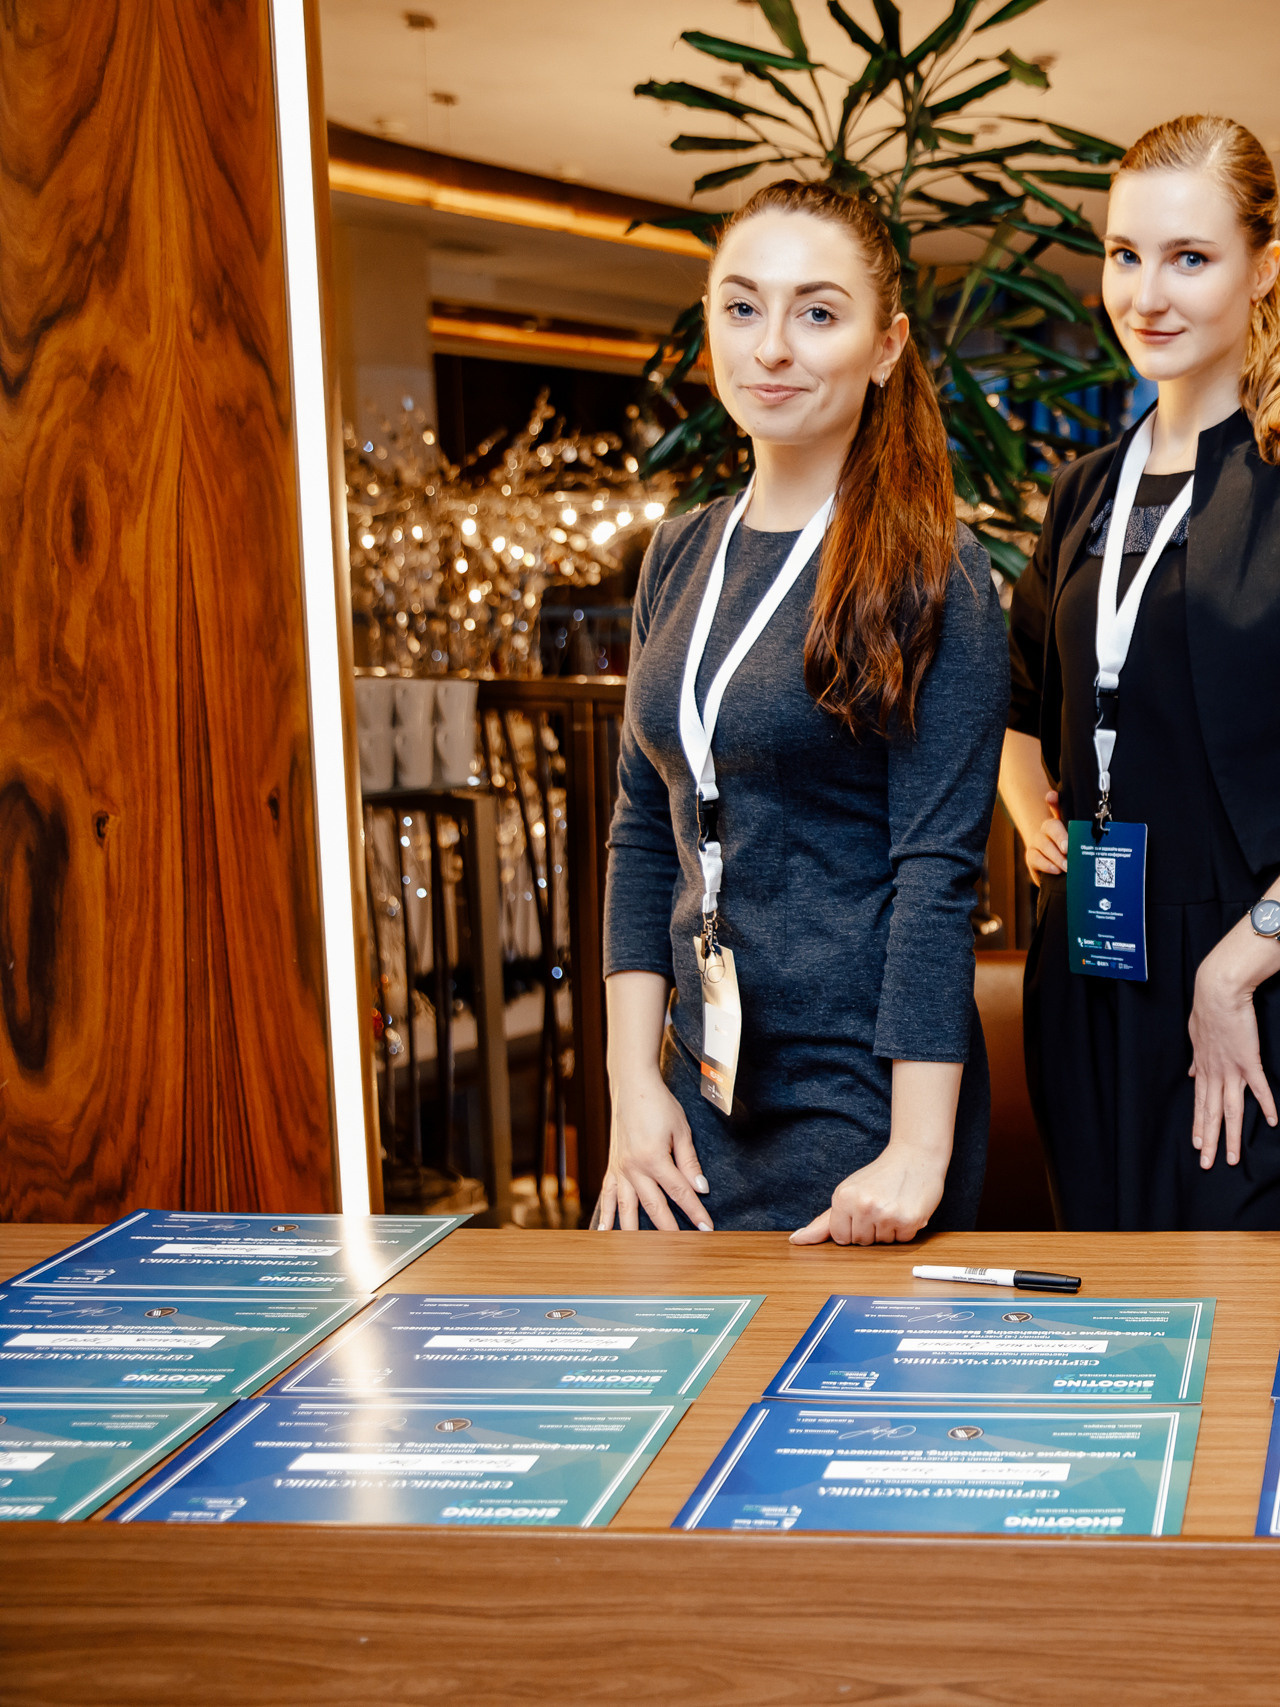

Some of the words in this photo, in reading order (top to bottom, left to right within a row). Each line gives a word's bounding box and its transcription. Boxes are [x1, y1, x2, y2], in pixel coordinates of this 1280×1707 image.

[991, 1358, 1099, 1366] СЕРТИФИКАТ
[386, 1480, 514, 1489] СЕРТИФИКАТ
[816, 1487, 931, 1497] УЧАСТНИКА
[933, 1488, 1059, 1498] СЕРТИФИКАТ
[440, 1507, 563, 1515] SHOOTING
[1004, 1517, 1123, 1525] SHOOTING
